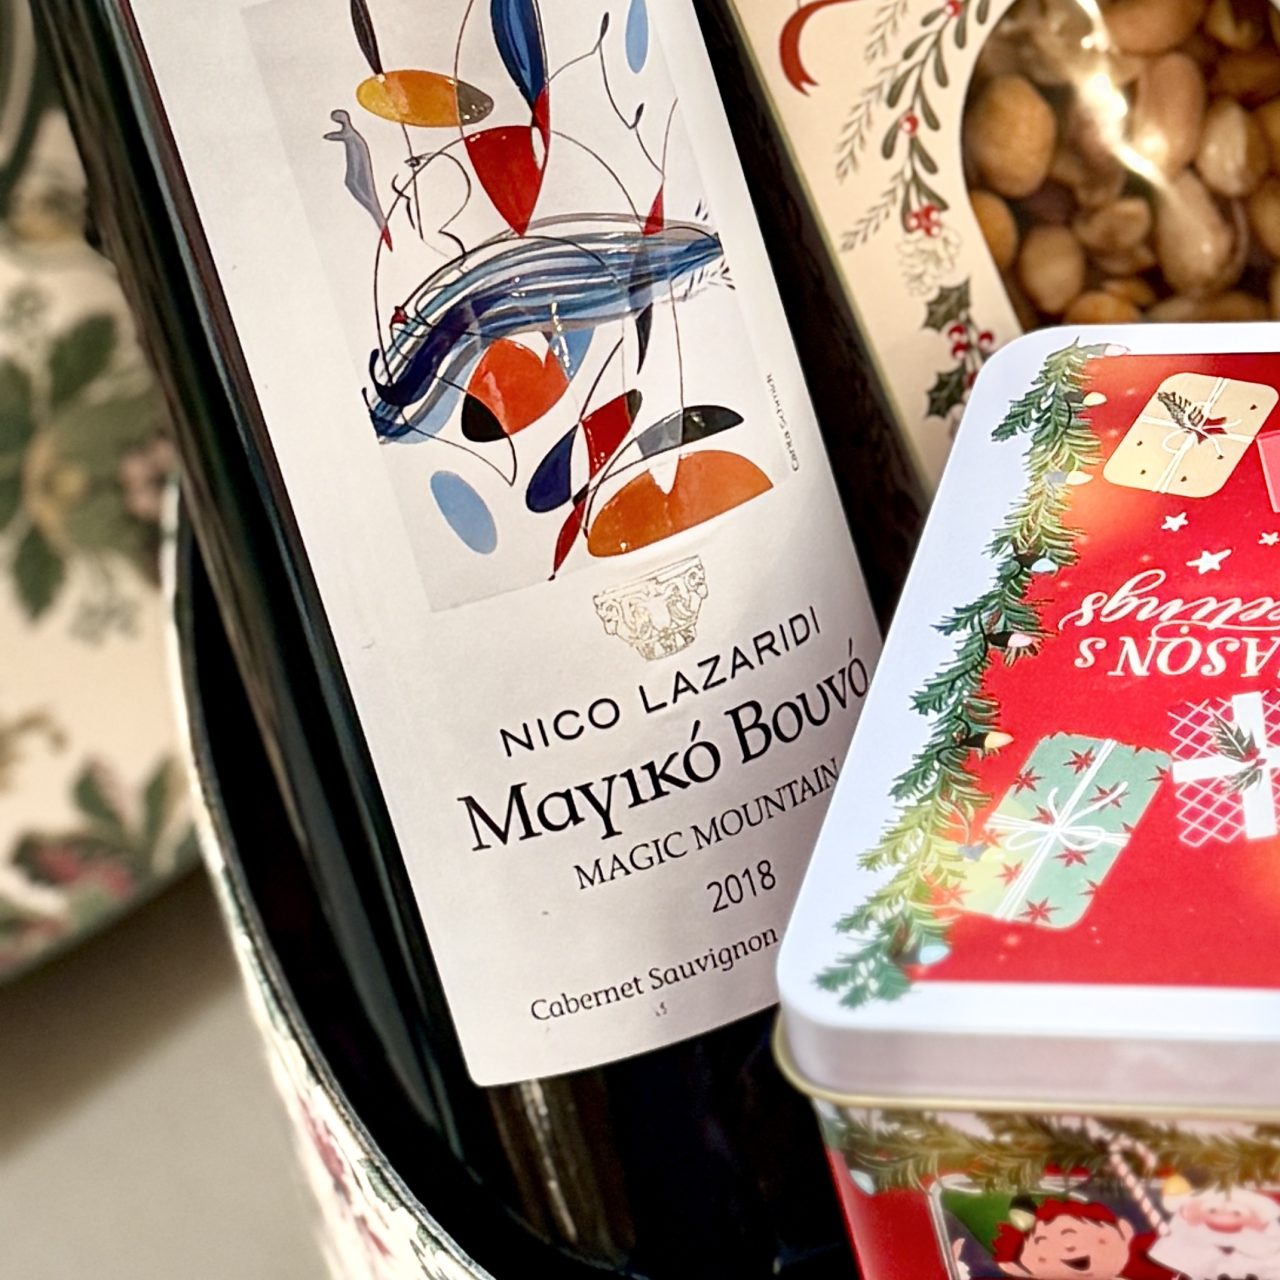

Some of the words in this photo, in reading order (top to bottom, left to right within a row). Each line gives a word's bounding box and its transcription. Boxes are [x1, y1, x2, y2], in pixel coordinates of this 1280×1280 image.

[457, 719, 721, 851] Μαγικό
[724, 637, 869, 764] Βουνό
[499, 697, 621, 757] NICO
[639, 605, 820, 713] LAZARIDI
[573, 831, 688, 890] MAGIC
[690, 757, 839, 851] MOUNTAIN
[706, 860, 776, 913] 2018
[530, 976, 645, 1021] Cabernet
[648, 928, 779, 990] Sauvignon
